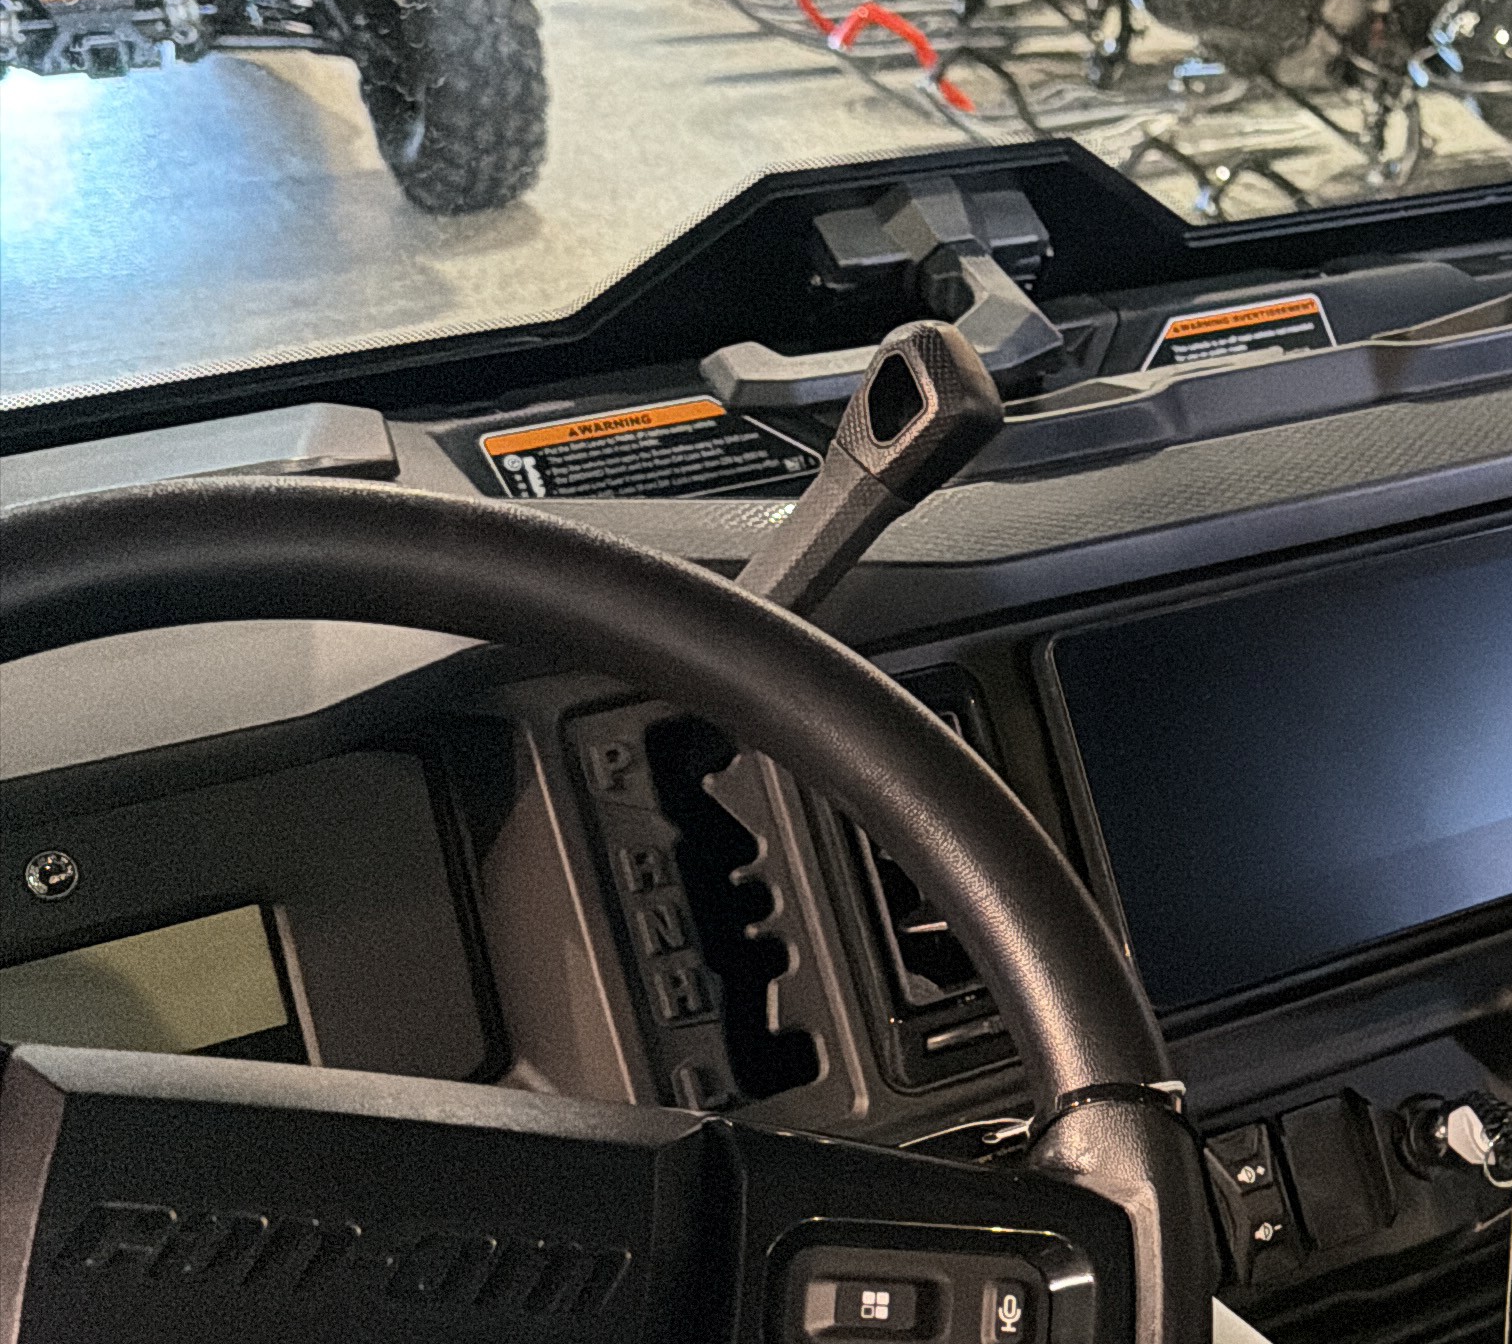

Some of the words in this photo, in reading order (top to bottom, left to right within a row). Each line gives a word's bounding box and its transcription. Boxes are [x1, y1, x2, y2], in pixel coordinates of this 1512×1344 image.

[579, 414, 652, 435] WARNING
[588, 742, 632, 790] P
[637, 905, 686, 955] N
